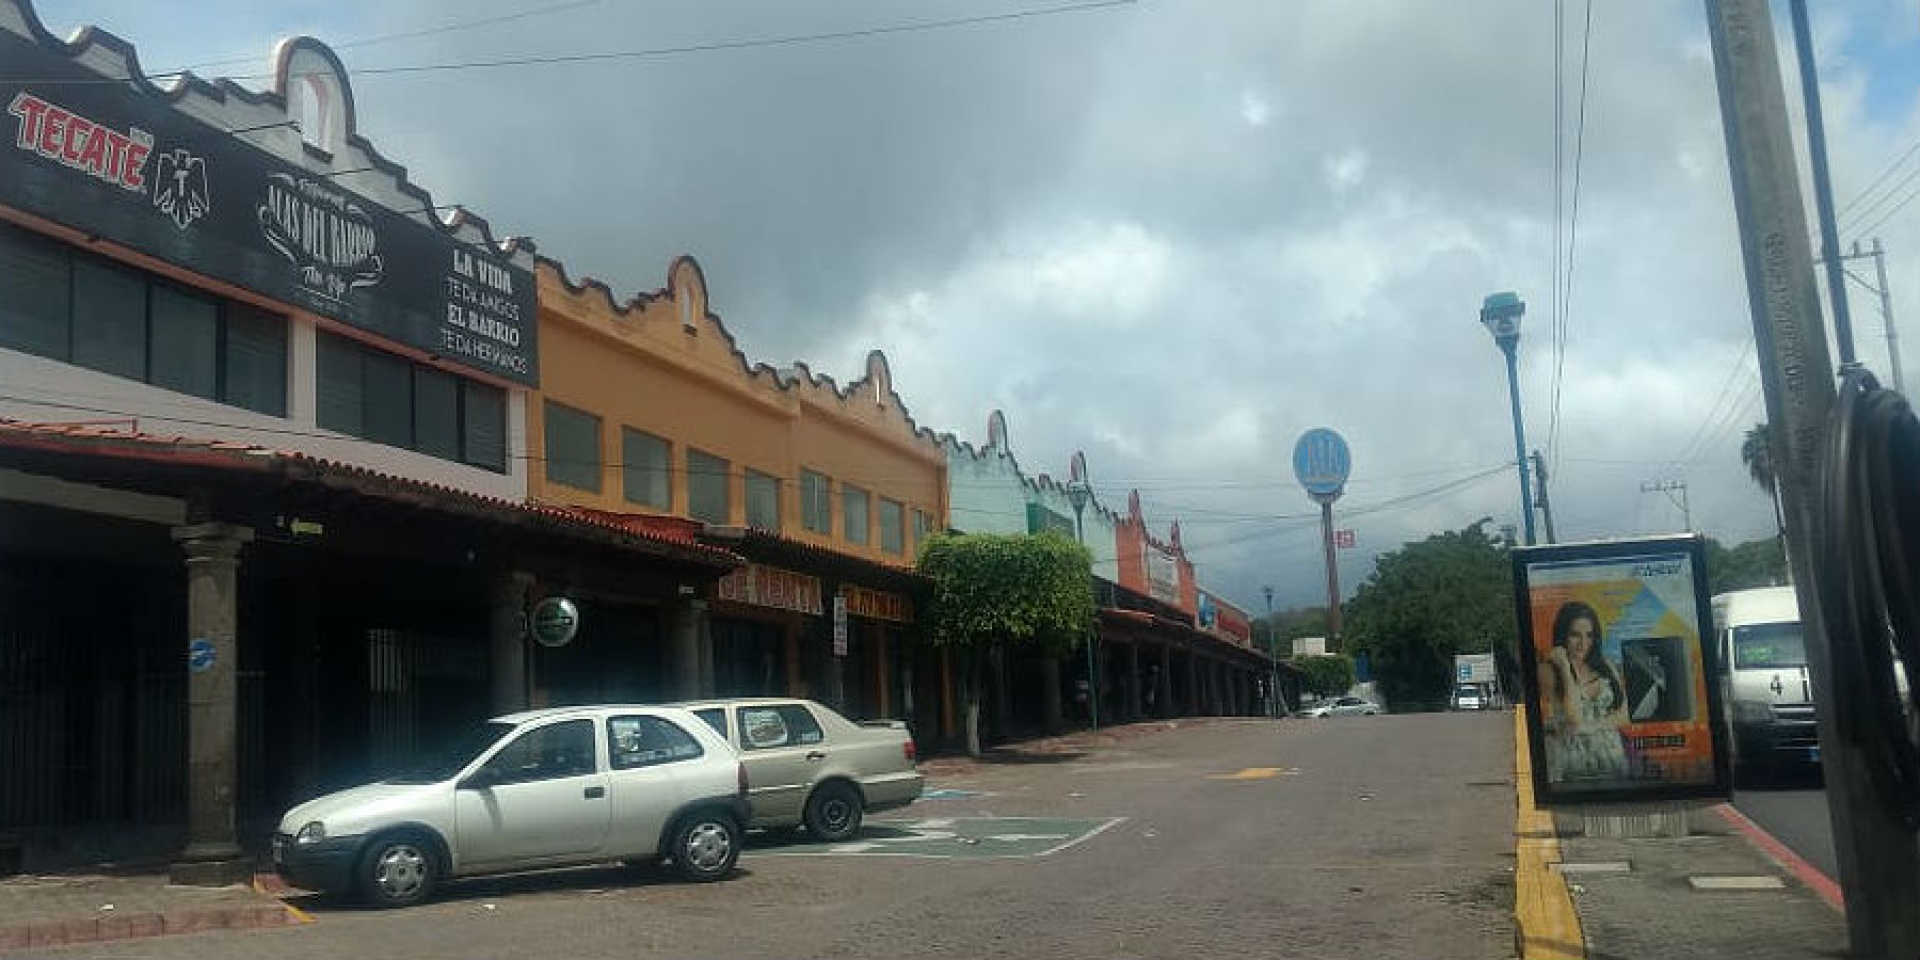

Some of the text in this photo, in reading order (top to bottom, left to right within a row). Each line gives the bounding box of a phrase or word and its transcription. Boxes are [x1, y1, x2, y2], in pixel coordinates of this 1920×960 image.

[9, 93, 153, 191] TECATE
[267, 184, 300, 243] ALAS
[303, 202, 328, 263] DEL
[331, 215, 376, 267] BARRIO
[454, 248, 513, 295] LA VIDA
[448, 302, 520, 347] EL BARRIO
[1769, 680, 1783, 696] 4
